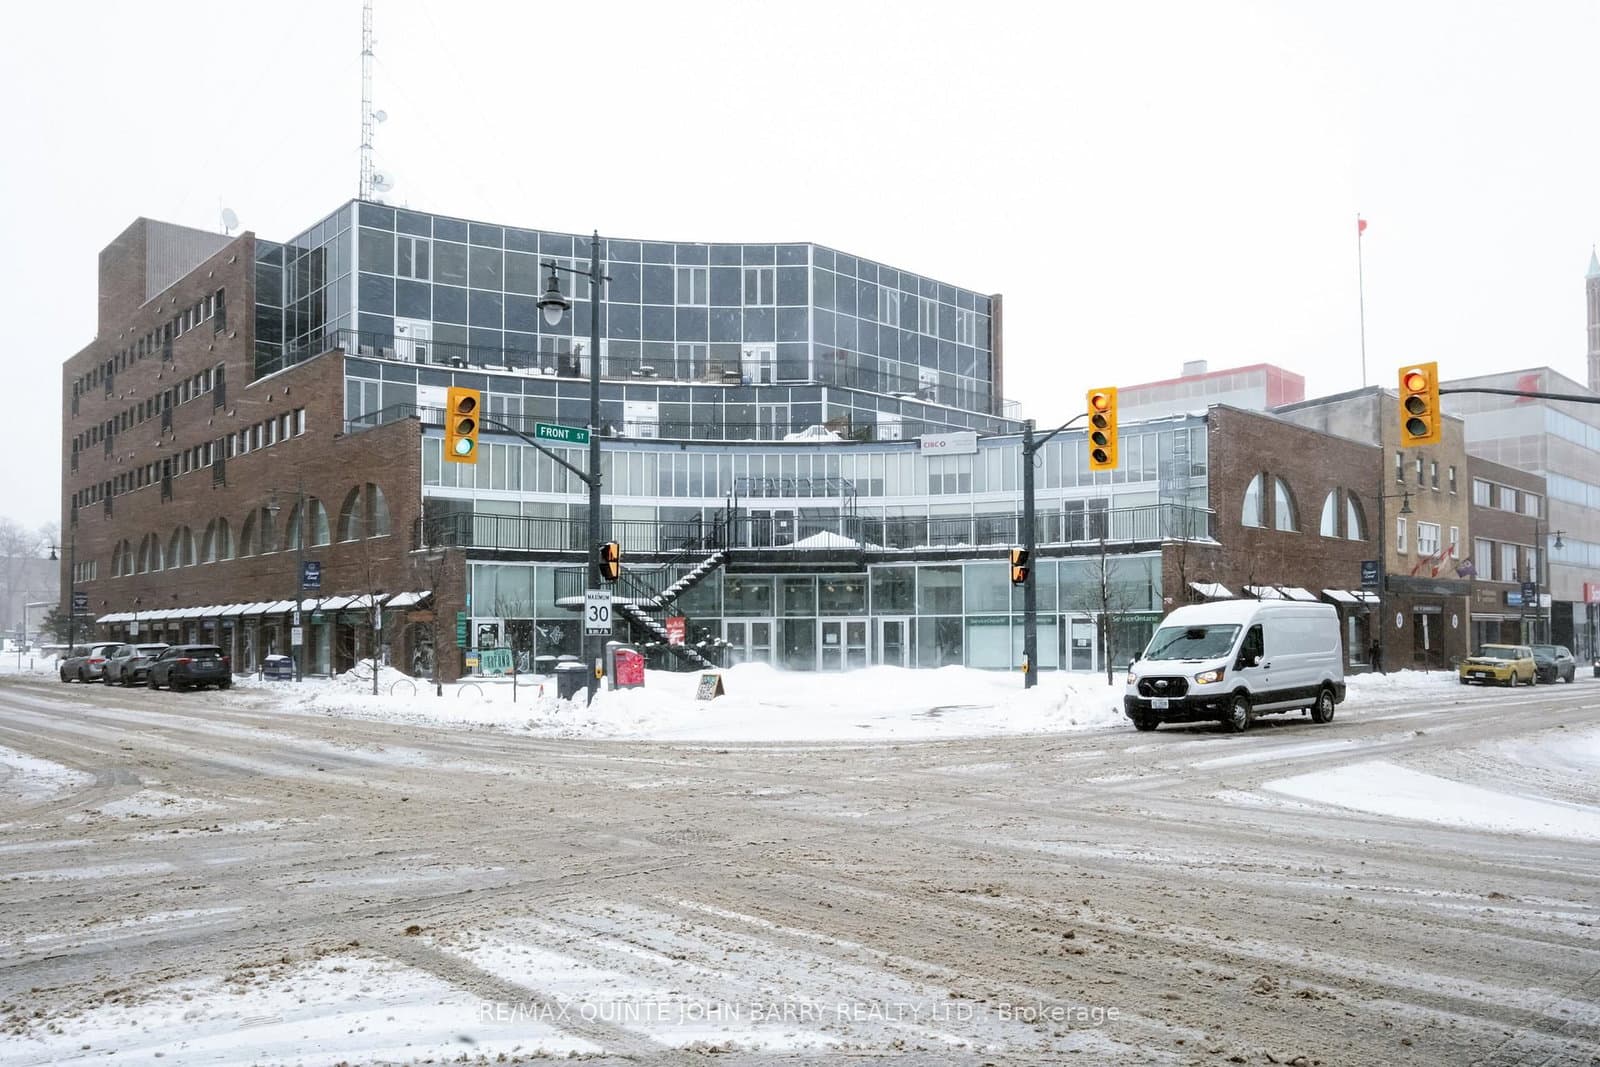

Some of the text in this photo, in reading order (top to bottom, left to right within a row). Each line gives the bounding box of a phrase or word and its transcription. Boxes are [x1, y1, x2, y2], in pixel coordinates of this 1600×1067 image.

[541, 427, 584, 440] FRONT ST
[589, 605, 609, 622] 30
